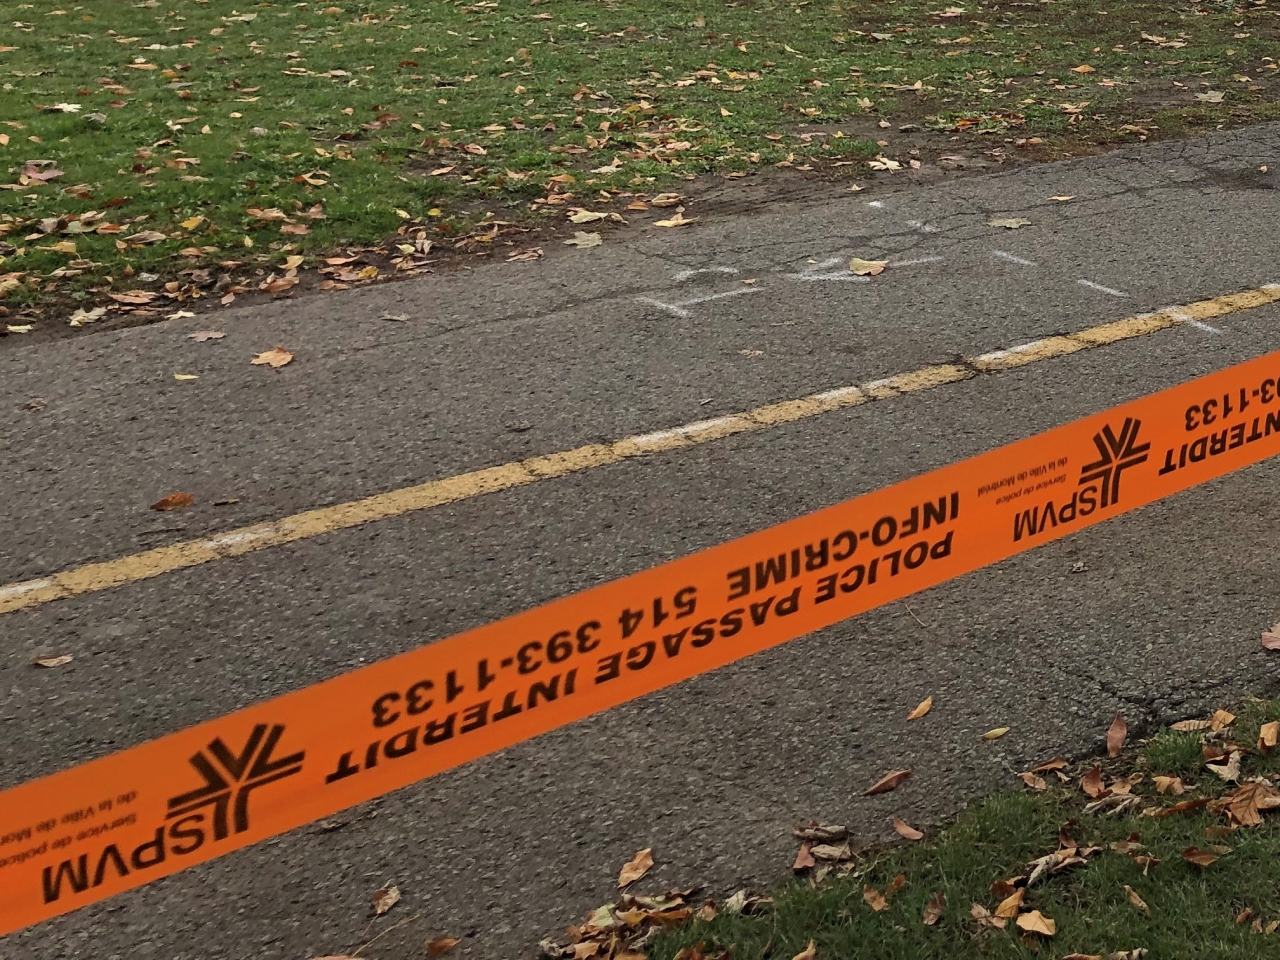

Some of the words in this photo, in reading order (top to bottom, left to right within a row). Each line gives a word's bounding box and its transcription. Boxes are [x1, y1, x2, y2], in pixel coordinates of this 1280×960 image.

[1017, 471, 1028, 481] de
[1029, 464, 1047, 476] Ville
[1036, 474, 1066, 490] Service
[1057, 457, 1067, 467] de
[996, 488, 1022, 505] police
[1013, 485, 1098, 542] SPVM
[1023, 485, 1034, 495] de
[727, 492, 959, 601] INFO-CRIME
[814, 531, 954, 605] POLICE
[594, 587, 801, 685] PASSAGE
[618, 586, 697, 639] 514
[371, 621, 601, 728] 393-1133
[325, 668, 577, 785] INTERDIT
[42, 814, 206, 904] SPVM
